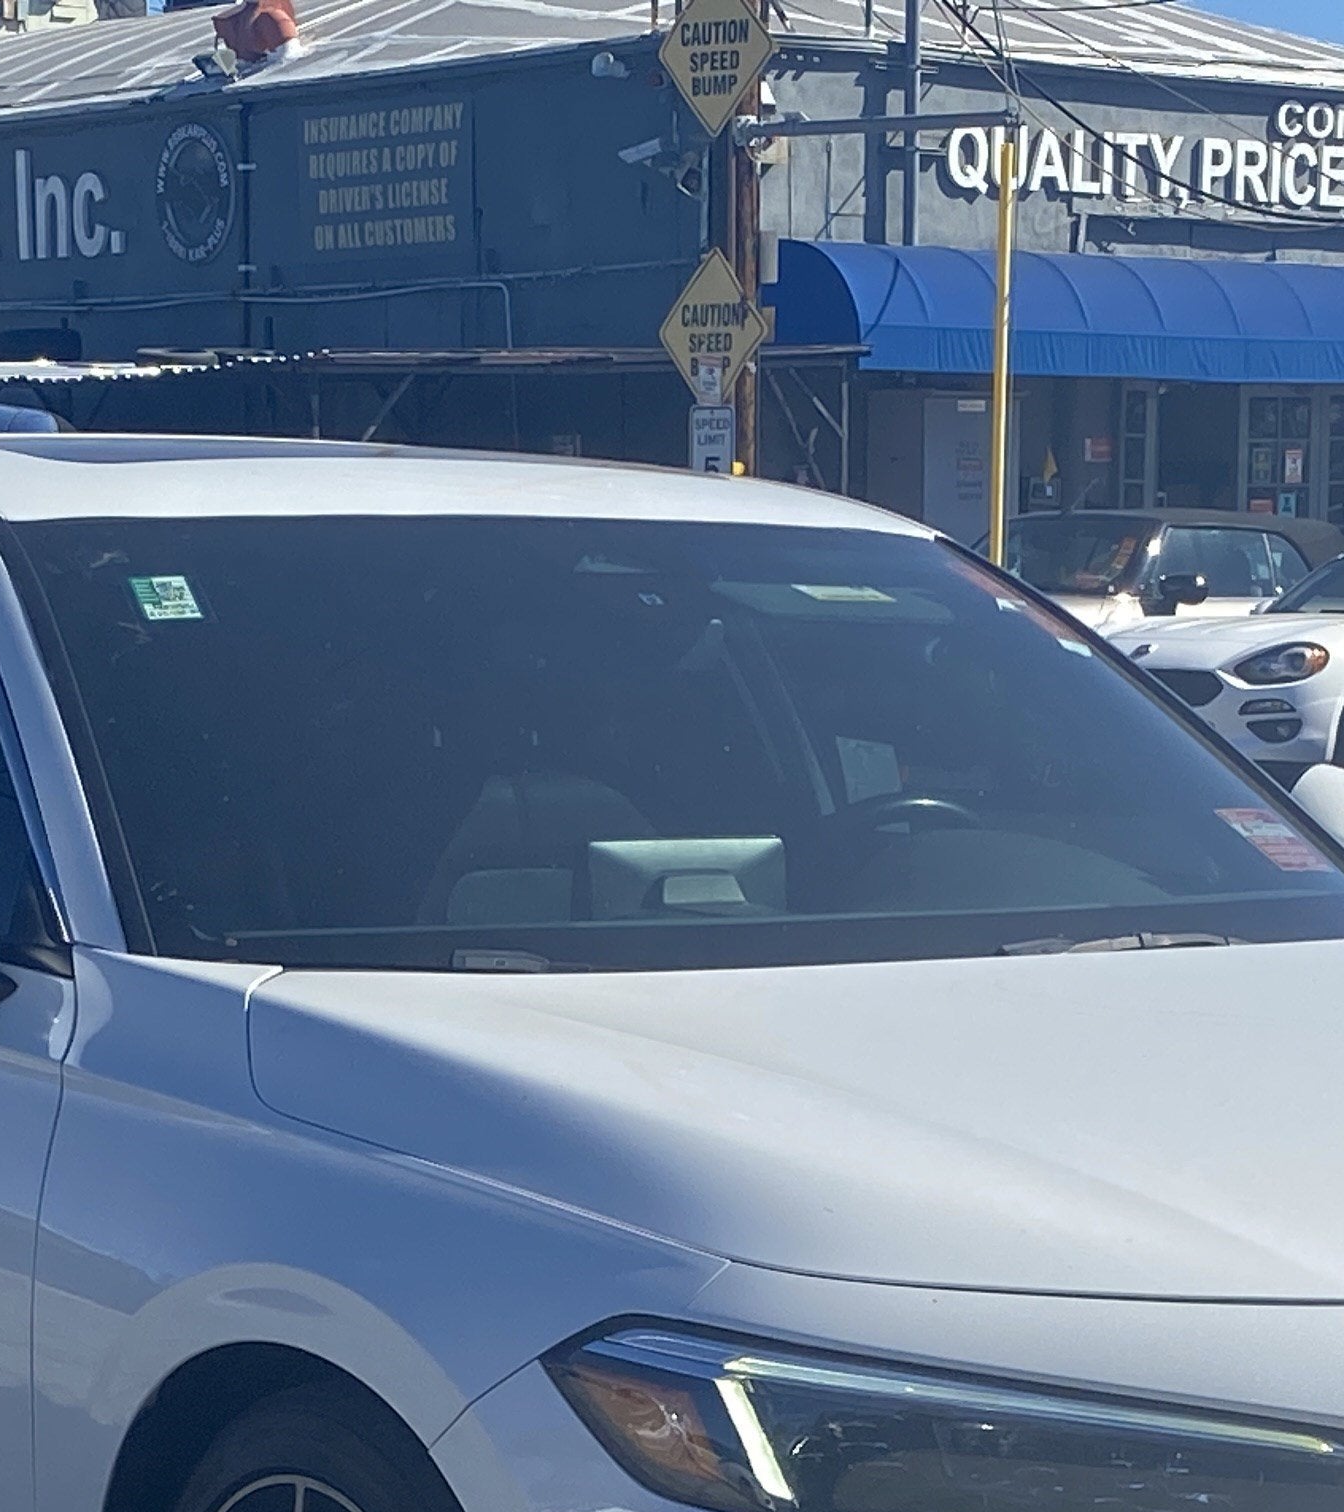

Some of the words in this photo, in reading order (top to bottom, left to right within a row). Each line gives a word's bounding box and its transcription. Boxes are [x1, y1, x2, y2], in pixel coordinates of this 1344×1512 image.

[681, 19, 749, 46] CAUTION
[690, 50, 740, 72] SPEED
[692, 74, 738, 97] BUMP
[304, 111, 386, 144] INSURANCE
[390, 102, 463, 136] COMPANY
[309, 148, 377, 181] REQUIRES
[382, 148, 392, 172] A
[396, 142, 435, 171] COPY
[439, 140, 458, 167] OF
[947, 125, 1192, 208] QUALITY,
[15, 149, 126, 261] Inc.
[318, 183, 384, 214] DRIVER'S
[387, 178, 448, 208] LICENSE
[314, 225, 334, 250] ON
[338, 222, 361, 249] ALL
[364, 215, 456, 246] CUSTOMERS
[681, 303, 746, 328] CAUTION
[689, 333, 733, 353] SPEED
[690, 356, 731, 377] BP
[695, 418, 730, 430] SPEED
[697, 433, 725, 446] LIMIT
[705, 456, 720, 472] 5
